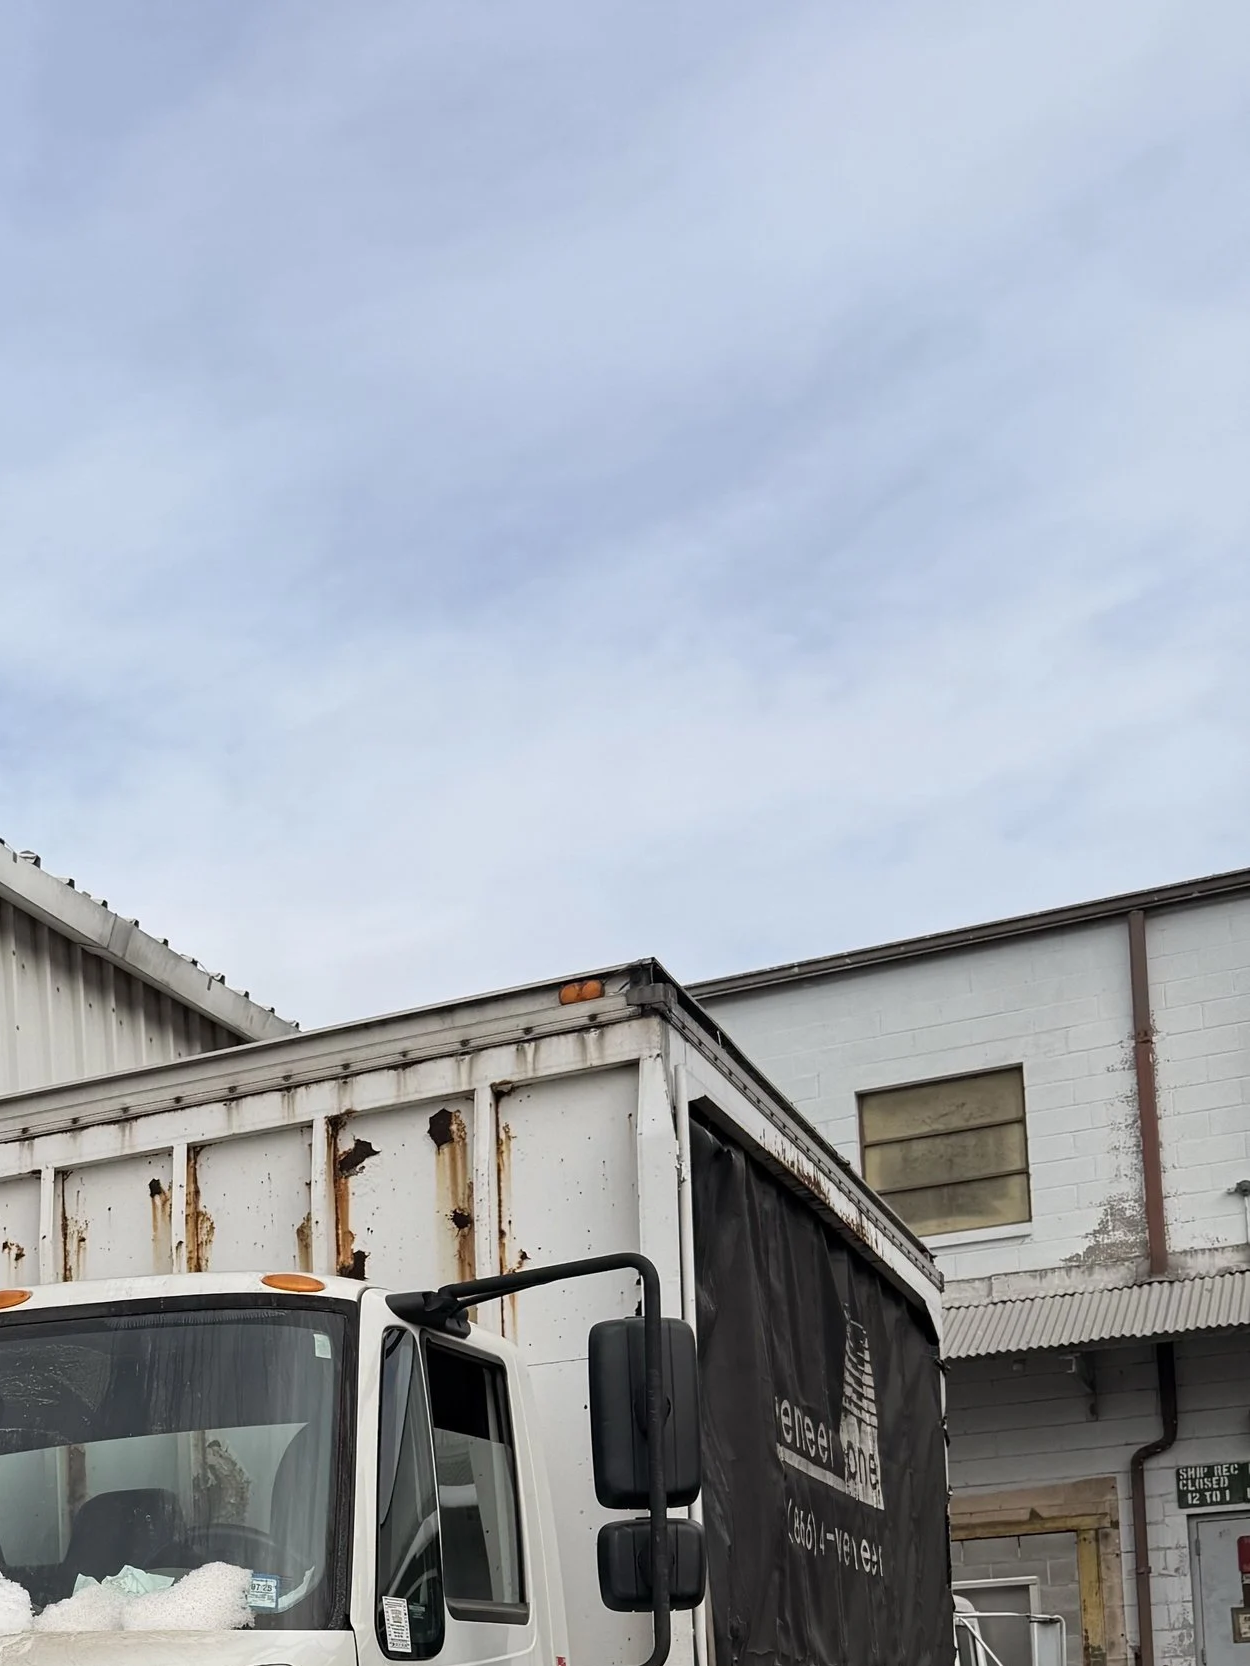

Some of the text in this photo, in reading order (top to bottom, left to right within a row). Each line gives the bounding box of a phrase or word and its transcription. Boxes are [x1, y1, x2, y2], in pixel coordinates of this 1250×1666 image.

[775, 1396, 834, 1468] eneer
[1179, 1463, 1239, 1480] SHIP REC
[1179, 1476, 1229, 1491] CLOSED
[1187, 1489, 1230, 1505] 12 TO 1
